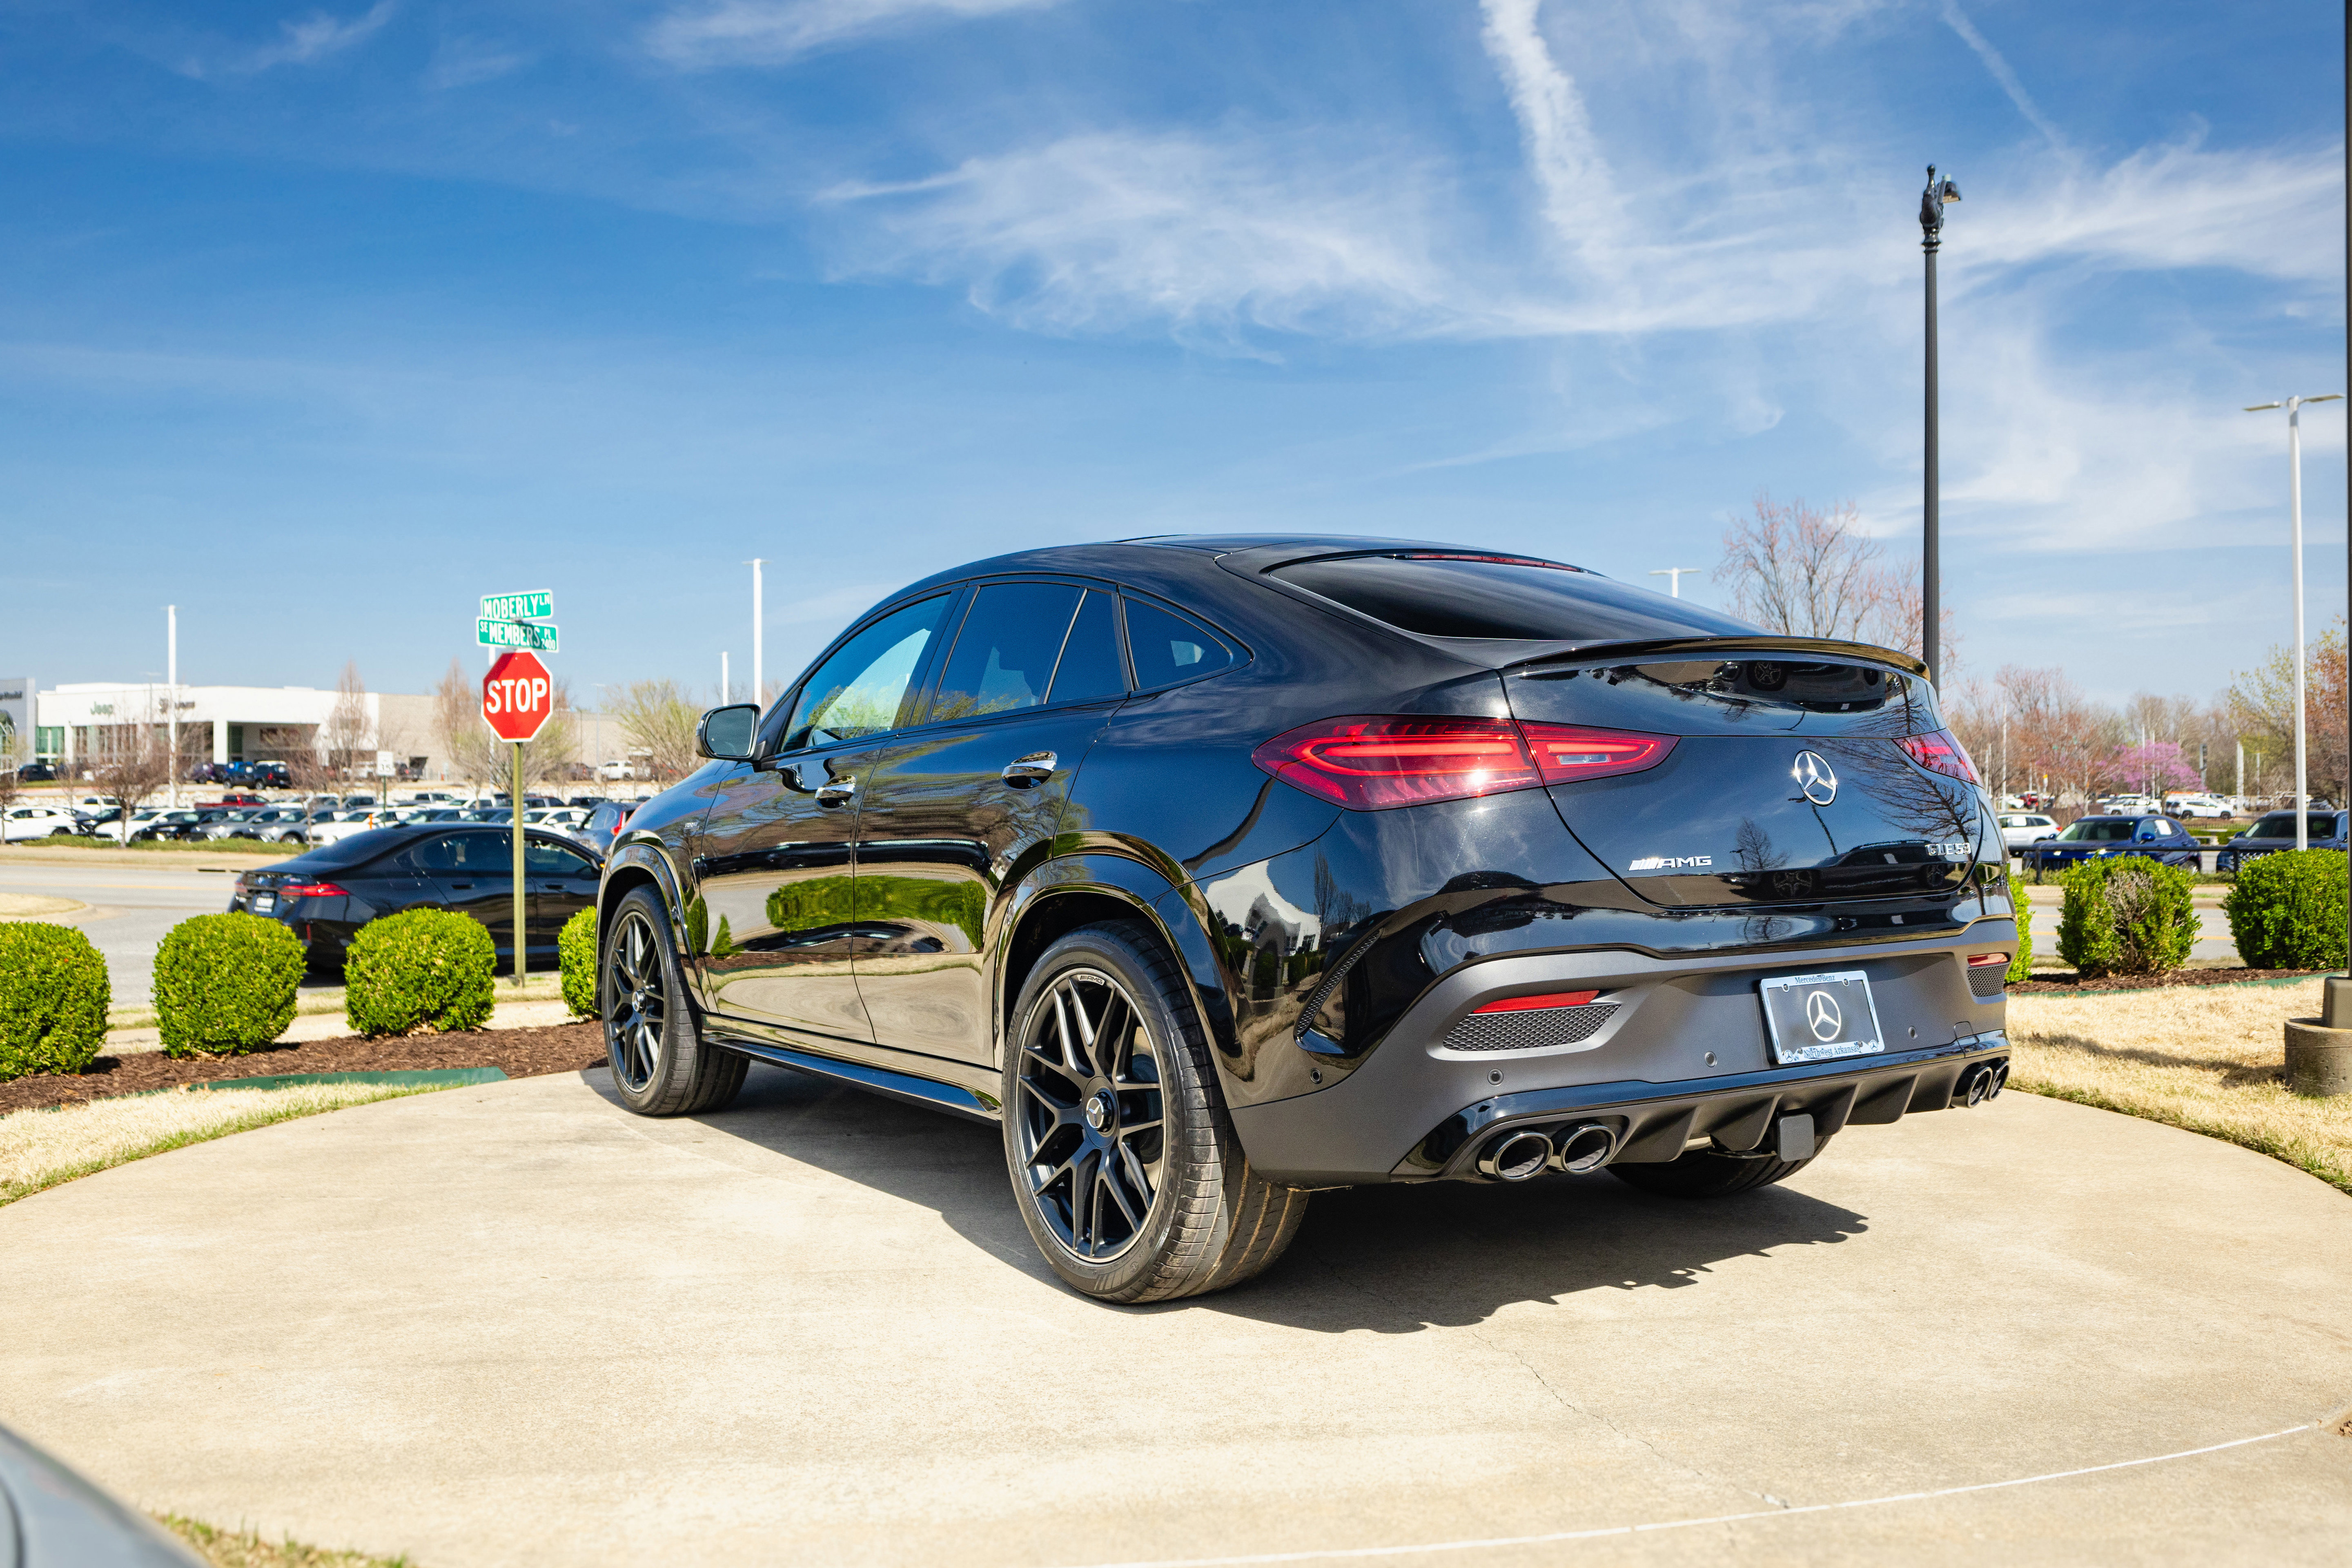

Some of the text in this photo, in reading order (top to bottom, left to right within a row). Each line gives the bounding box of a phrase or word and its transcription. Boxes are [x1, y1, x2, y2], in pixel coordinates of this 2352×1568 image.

[484, 594, 550, 619] MOBERLY LN
[480, 621, 552, 647] SE MEMBERS PL
[541, 638, 556, 650] 2400
[486, 678, 547, 713] STOP
[90, 701, 113, 717] Jeep
[1925, 842, 1971, 855] GLE 53
[1656, 856, 1712, 869] AMG
[1087, 975, 1102, 983] AMG
[1795, 974, 1835, 984] Mercedes-Benz
[1002, 1011, 1019, 1086] YOKOHAMA
[1804, 1045, 1862, 1059] Northwest Arkansas
[1160, 1050, 1180, 1169] ADVAN
